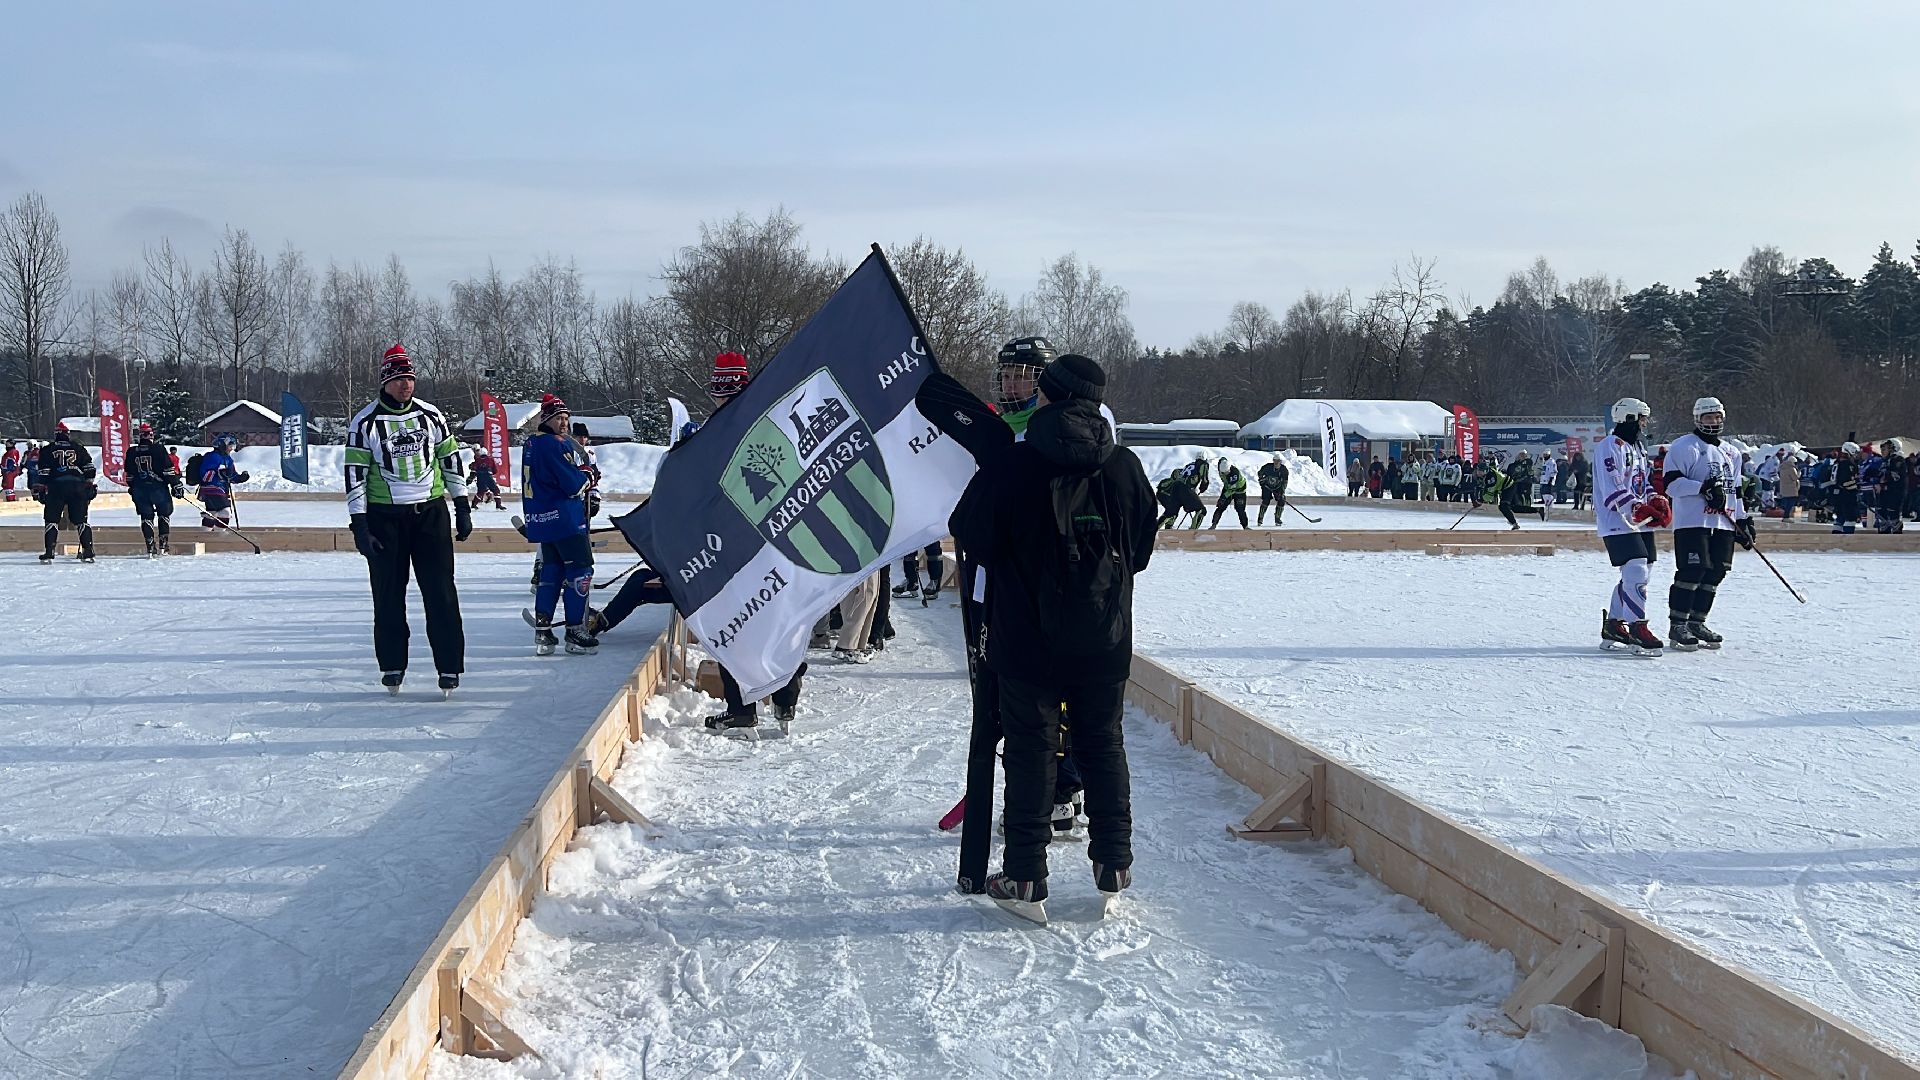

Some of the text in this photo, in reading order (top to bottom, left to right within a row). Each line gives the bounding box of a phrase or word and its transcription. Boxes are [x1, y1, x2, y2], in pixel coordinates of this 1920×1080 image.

[391, 443, 421, 453] POND
[52, 449, 77, 466] 72
[391, 450, 420, 459] HOCKEY
[135, 455, 152, 472] 17
[1464, 474, 1473, 483] 71
